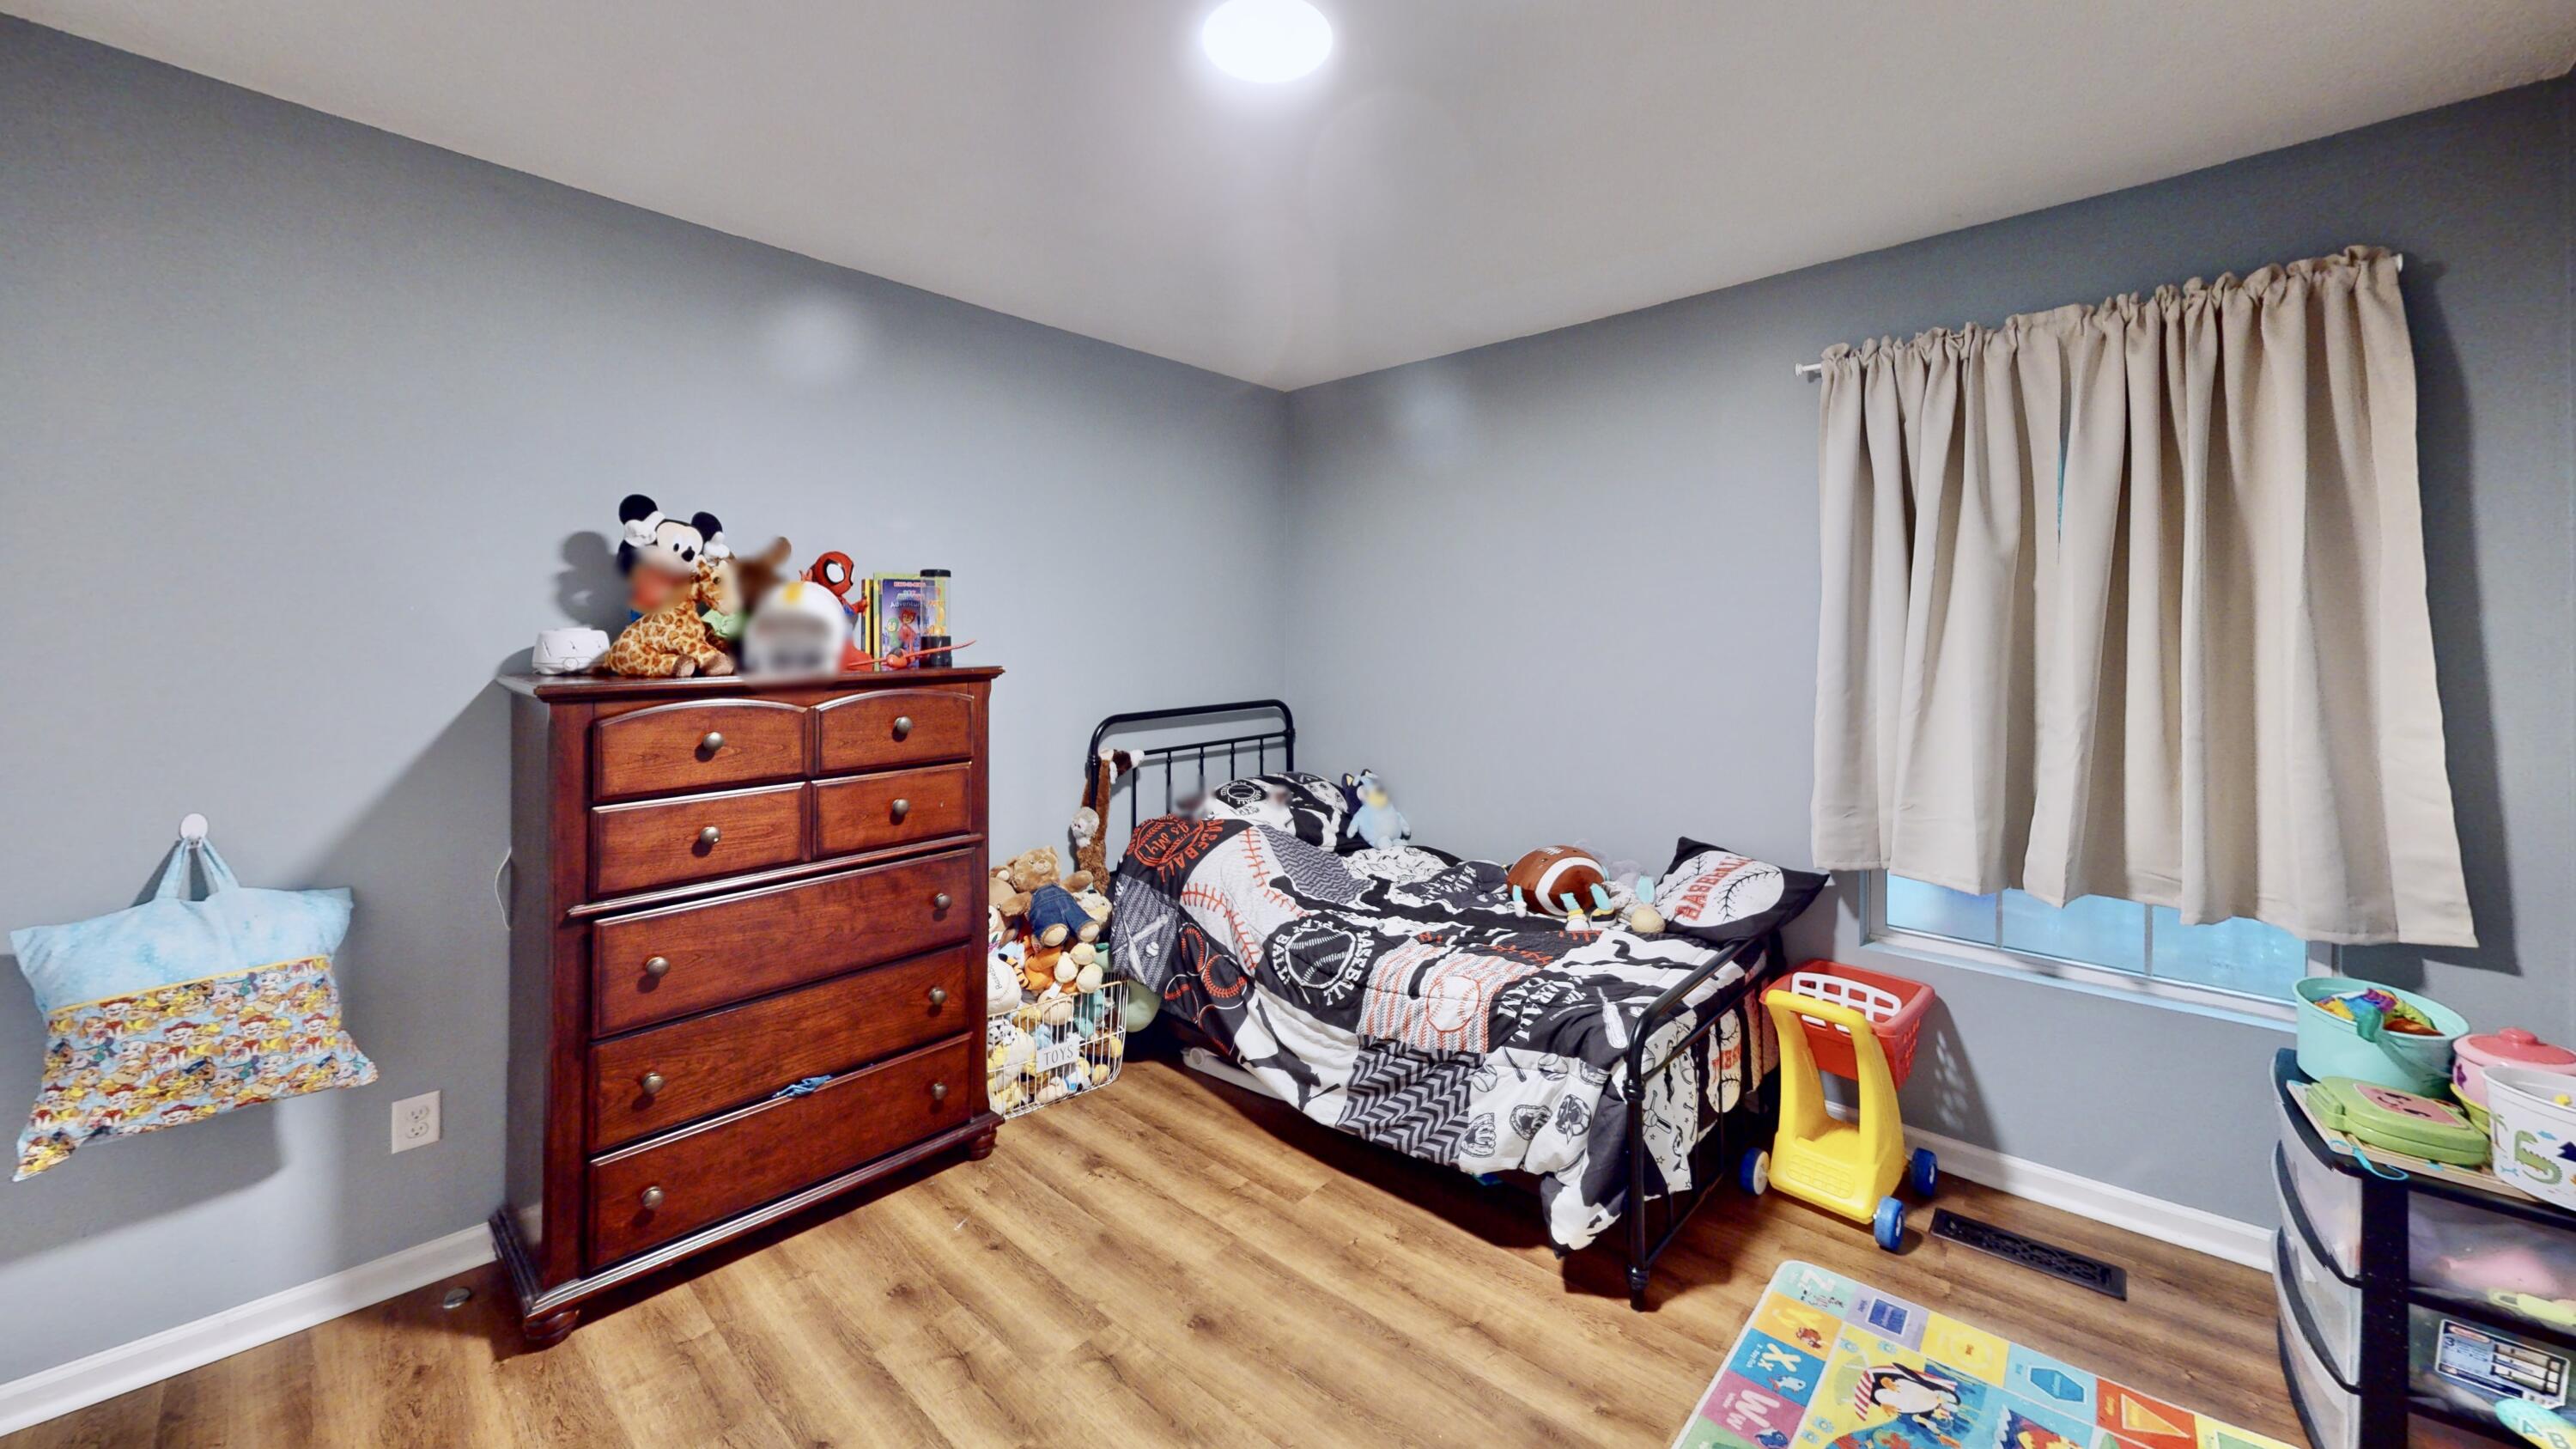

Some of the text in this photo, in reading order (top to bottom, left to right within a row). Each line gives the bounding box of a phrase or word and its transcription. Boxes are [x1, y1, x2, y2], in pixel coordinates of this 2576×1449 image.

[1323, 929, 1376, 1006] BASEBALL
[1043, 1044, 1074, 1066] TOYS
[2445, 1336, 2455, 1347] 3
[2522, 1419, 2572, 1449] A B
